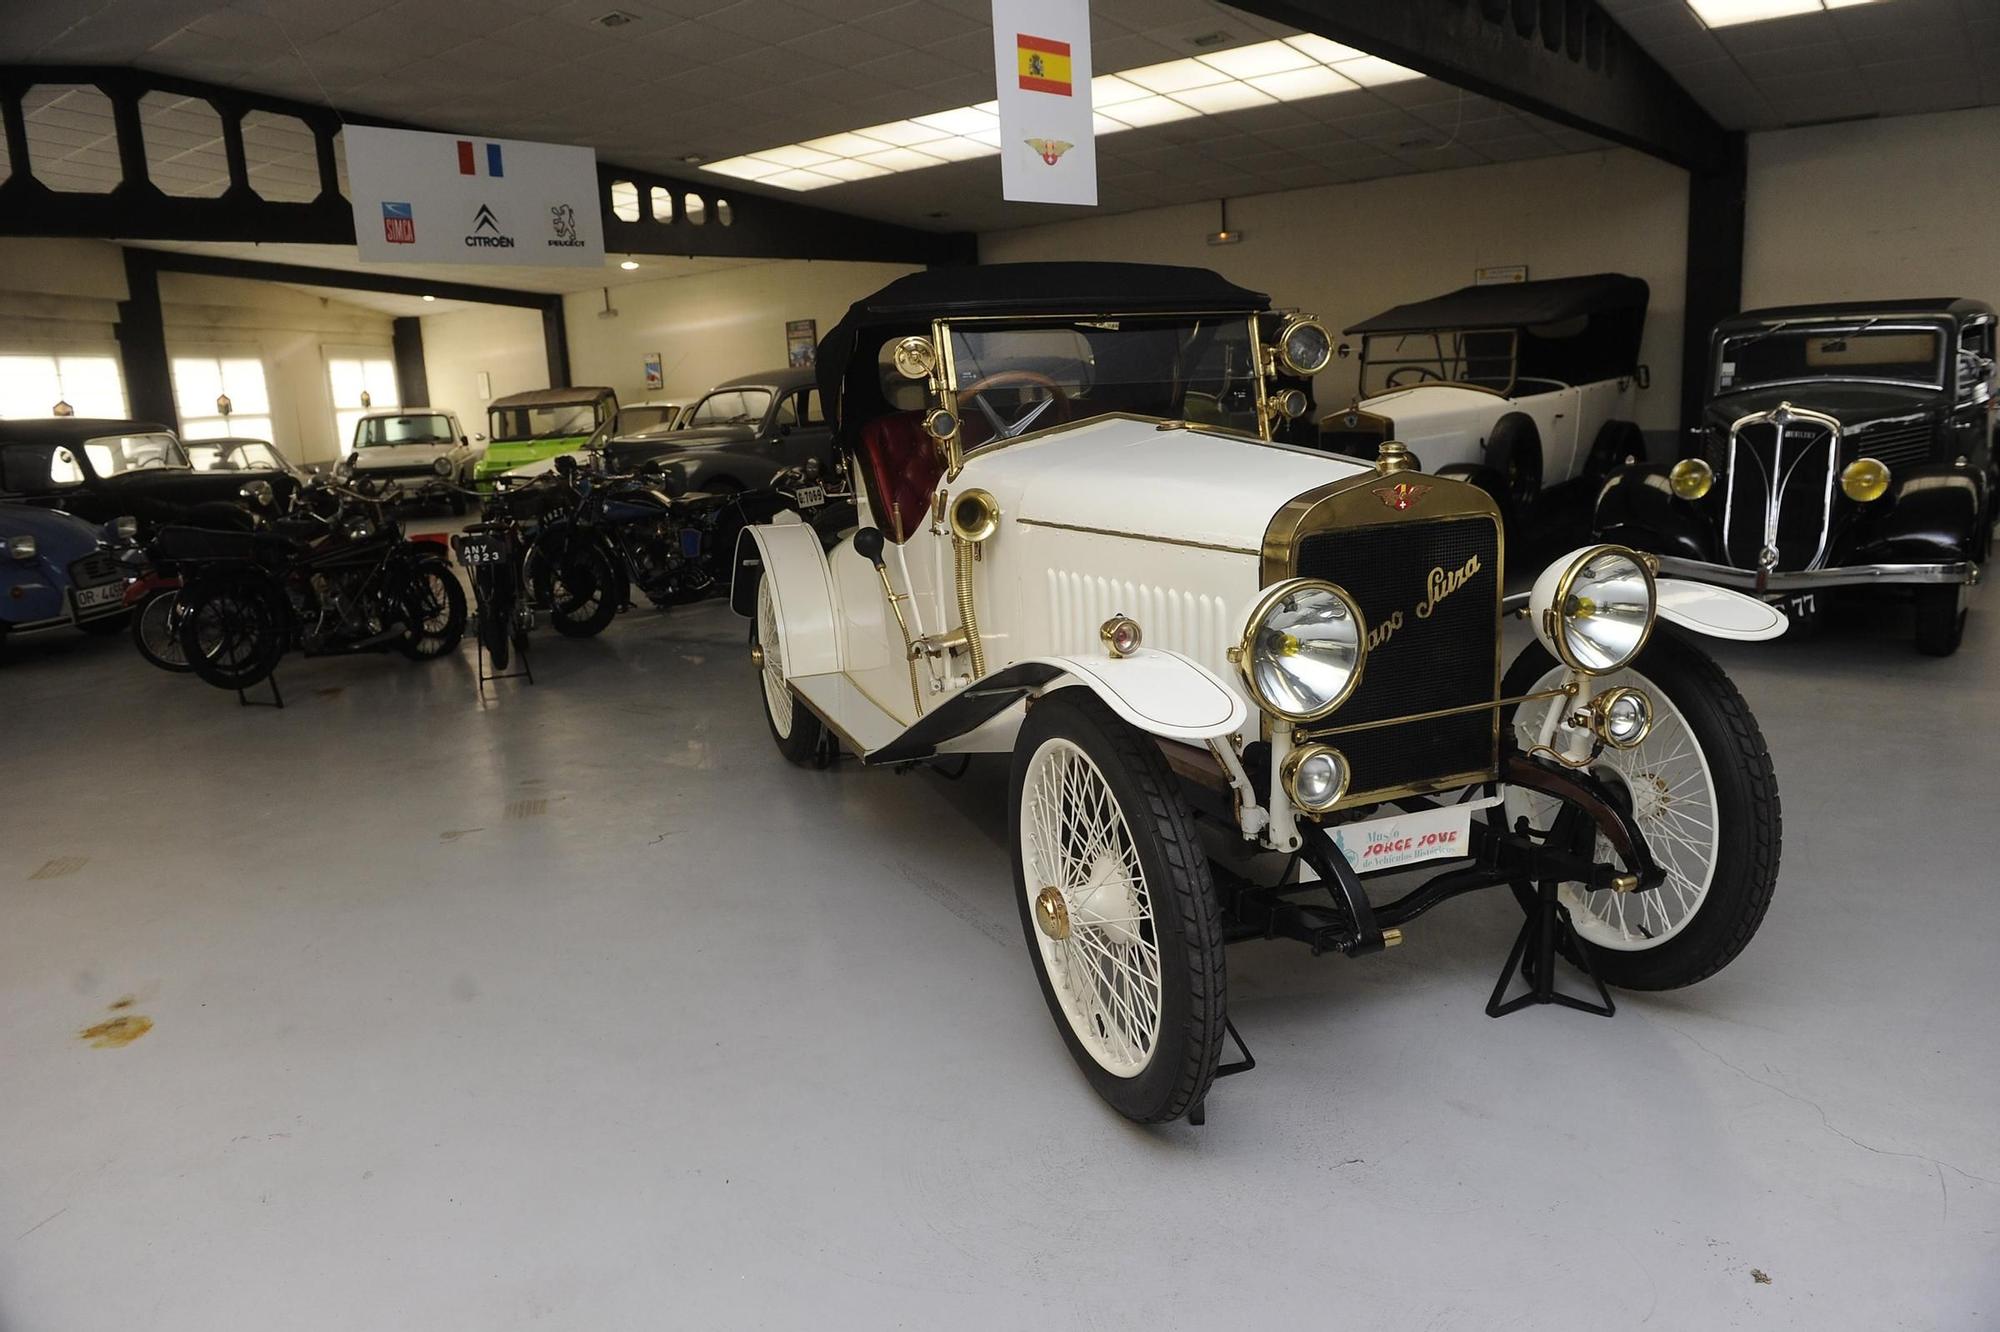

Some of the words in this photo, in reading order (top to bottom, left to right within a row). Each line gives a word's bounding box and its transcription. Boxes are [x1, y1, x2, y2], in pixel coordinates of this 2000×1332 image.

[386, 219, 413, 241] SIMCA
[465, 235, 515, 248] CITROËN
[464, 544, 488, 555] ANY
[465, 552, 500, 563] 1923
[1363, 838, 1412, 858] JORGE
[1418, 830, 1458, 848] JOVE
